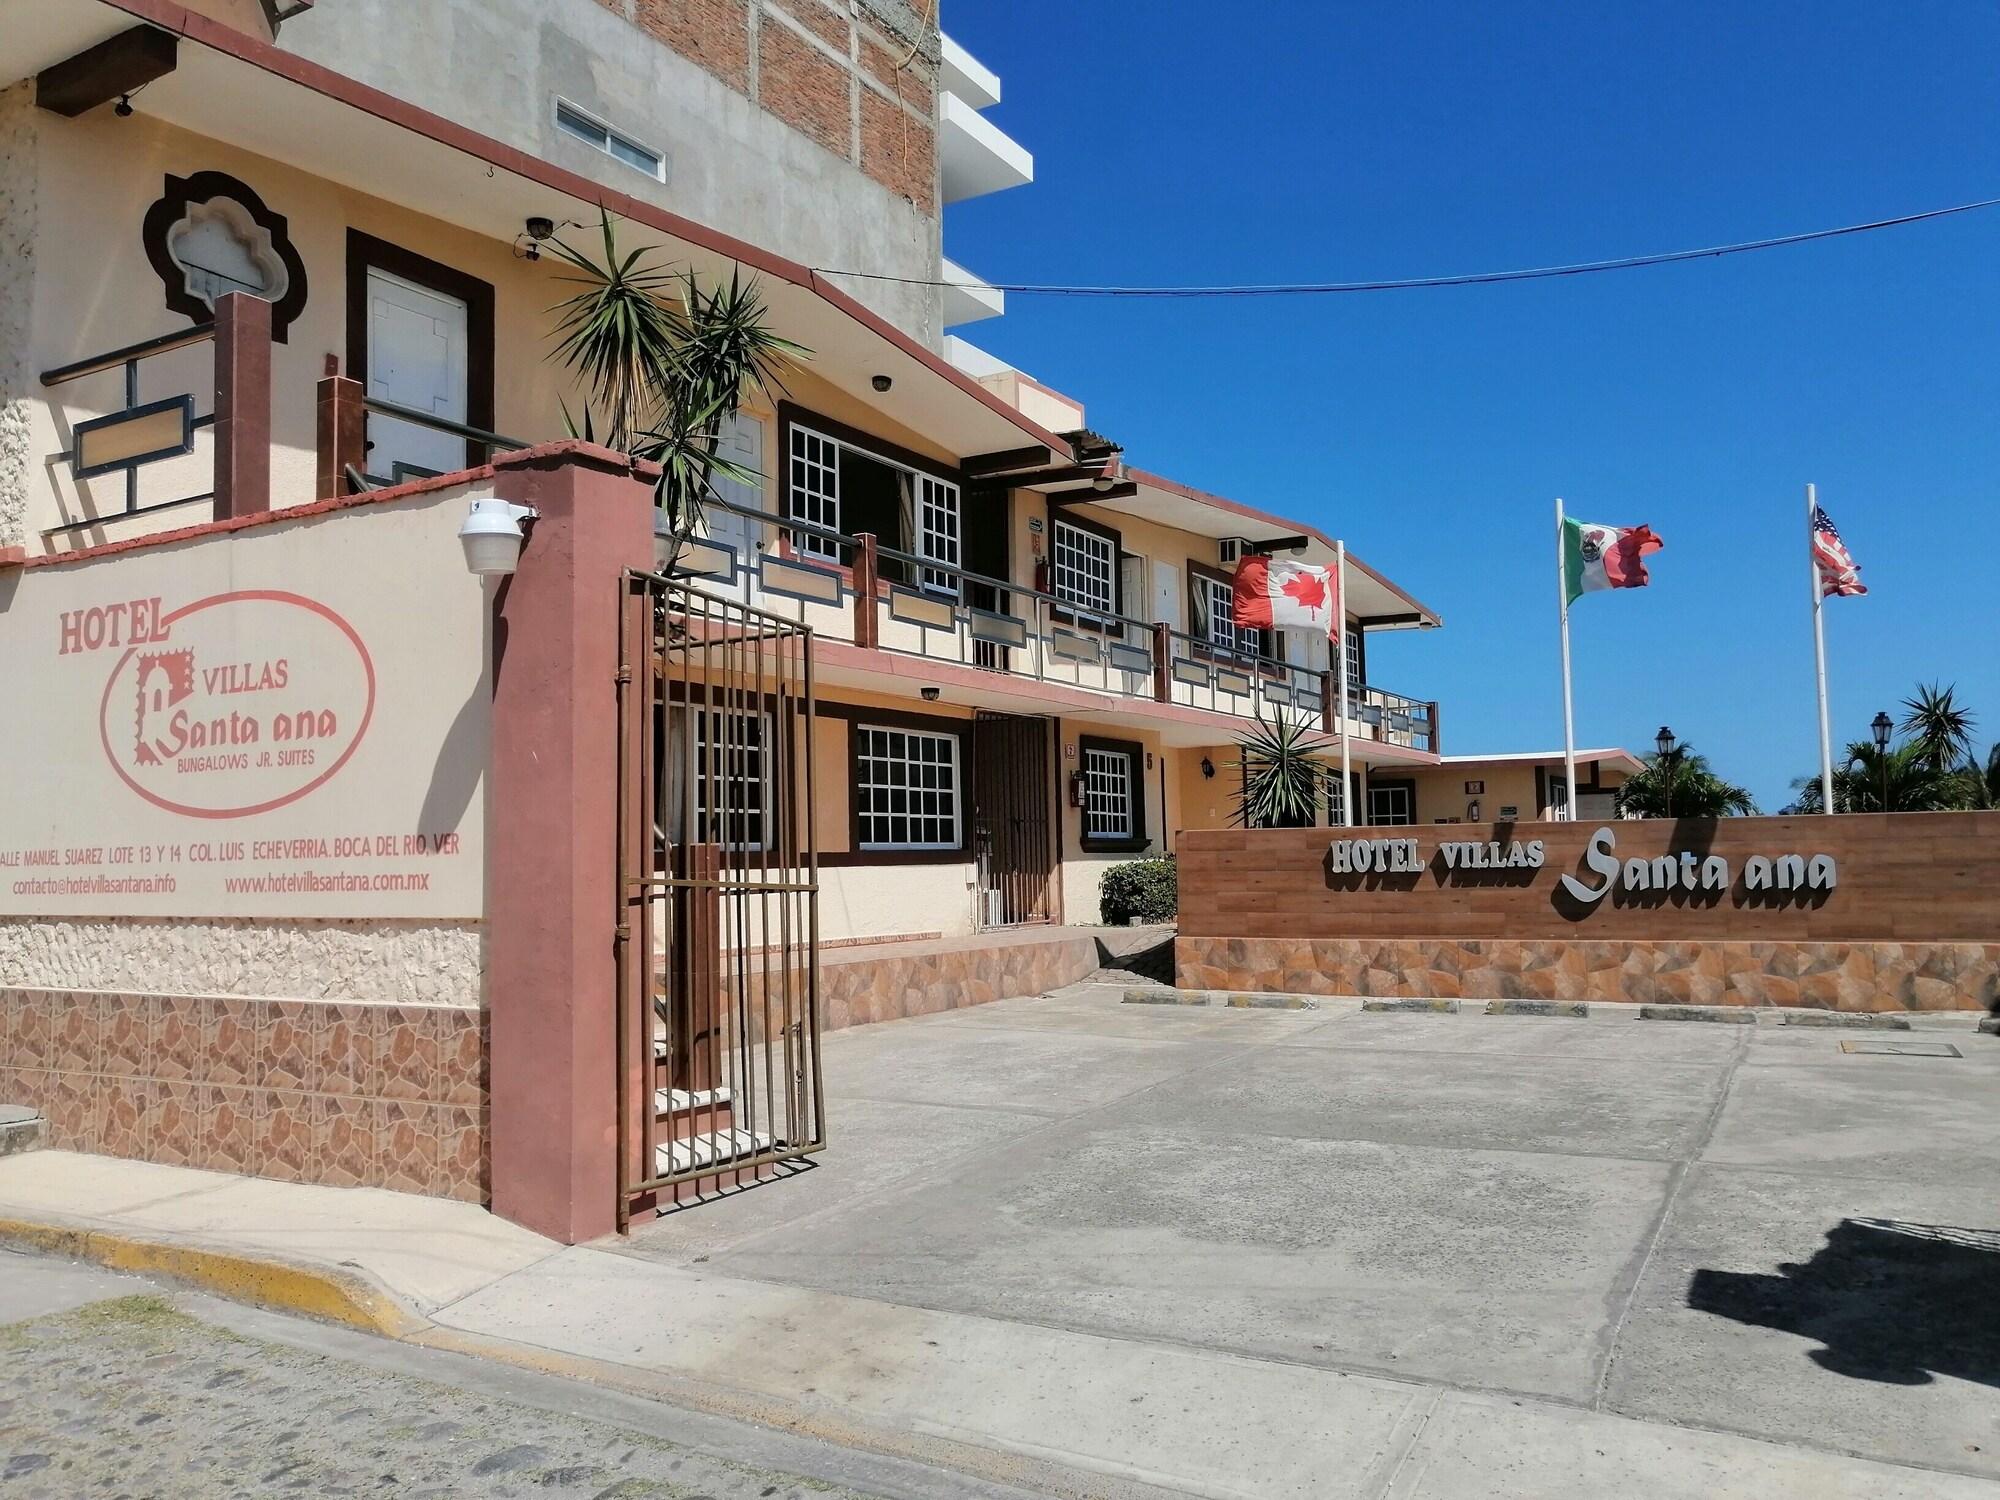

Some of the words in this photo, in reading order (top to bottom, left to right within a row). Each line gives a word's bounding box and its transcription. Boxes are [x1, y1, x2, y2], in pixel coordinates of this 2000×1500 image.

[59, 597, 171, 655] HOTEL
[202, 659, 288, 696] VILLAS
[155, 709, 259, 758] Santa
[273, 708, 337, 742] ana
[177, 753, 248, 773] BUNGALOWS
[256, 751, 273, 768] JR.
[277, 749, 315, 767] SUITES
[24, 849, 60, 867] MANUEL
[65, 847, 103, 865] SUAREZ
[109, 846, 134, 865] LOTE
[139, 846, 152, 864] 13
[156, 845, 166, 863] Y
[170, 845, 181, 863] 14
[189, 843, 217, 862] COL.
[219, 842, 245, 862] LUIS
[252, 839, 331, 860] ECHEVERRIA.
[334, 836, 372, 858] BOCA
[376, 835, 399, 857] DEL
[403, 834, 429, 857] RIO,
[434, 832, 460, 855] VER
[1330, 838, 1425, 874] HOTEL
[1440, 839, 1545, 870] VILLAS
[1561, 827, 1729, 903] Santa
[1744, 854, 1837, 892] ana
[13, 873, 176, 895] contacto@hotelvillasantana.info
[225, 870, 430, 894] www.hotelvillasantana.com.mx
